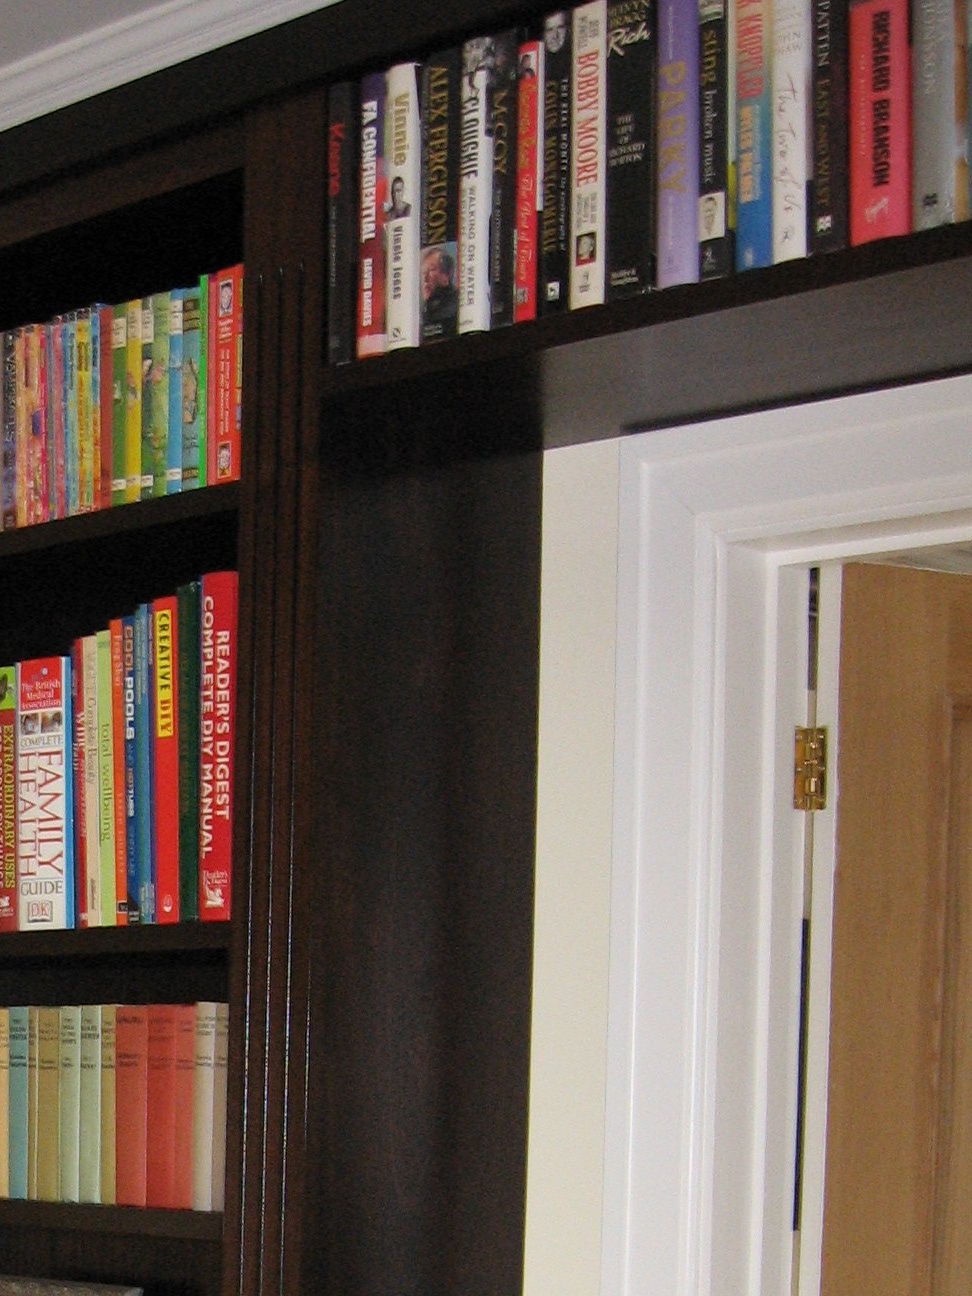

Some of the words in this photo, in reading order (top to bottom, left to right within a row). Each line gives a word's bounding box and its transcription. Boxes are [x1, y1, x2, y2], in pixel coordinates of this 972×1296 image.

[607, 22, 650, 57] Rich
[702, 30, 717, 88] sting
[737, 13, 764, 98] KNOPFLER
[817, 1, 830, 67] PATTEN
[872, 11, 891, 93] RICHARD
[429, 66, 449, 119] ALEX
[559, 79, 569, 97] THE
[577, 49, 599, 112] BOBBY
[776, 72, 798, 116] The
[361, 100, 378, 126] FA
[392, 93, 410, 167] Vinnie
[559, 103, 569, 127] REAL
[660, 60, 688, 194] PARKY
[703, 88, 717, 137] broken
[559, 133, 569, 173] MONTY
[576, 116, 599, 188] MOORE
[702, 139, 716, 184] music
[776, 121, 797, 160] Two
[872, 98, 891, 188] BRANSON
[359, 126, 378, 243] CONFIDENTIAL
[428, 123, 448, 243] FERGUSON
[774, 166, 801, 191] of
[467, 186, 476, 241] WALKING
[391, 226, 404, 263] Vinnie
[467, 245, 475, 262] ON
[391, 267, 404, 300] Jones
[466, 266, 476, 305] WATER
[158, 612, 170, 691] CREATIVE
[201, 596, 215, 712] COMPLETE
[22, 682, 33, 692] The
[34, 679, 61, 690] British
[26, 689, 55, 701] Medical
[124, 676, 135, 740] POOLS
[216, 630, 230, 735] READER'S
[20, 734, 63, 748] COMPLETE
[101, 723, 111, 757] total
[160, 699, 172, 733] DIY
[201, 719, 214, 757] DIY
[3, 724, 15, 849] EXTRAORDINARY
[101, 766, 113, 842] wellbeing
[215, 740, 230, 820] DIGEST
[19, 751, 37, 877] HEALTH
[37, 750, 64, 876] FAMILY
[200, 764, 214, 859] MANUAL
[5, 852, 16, 888] USES
[20, 880, 63, 896] GUIDE
[31, 901, 50, 917] DK
